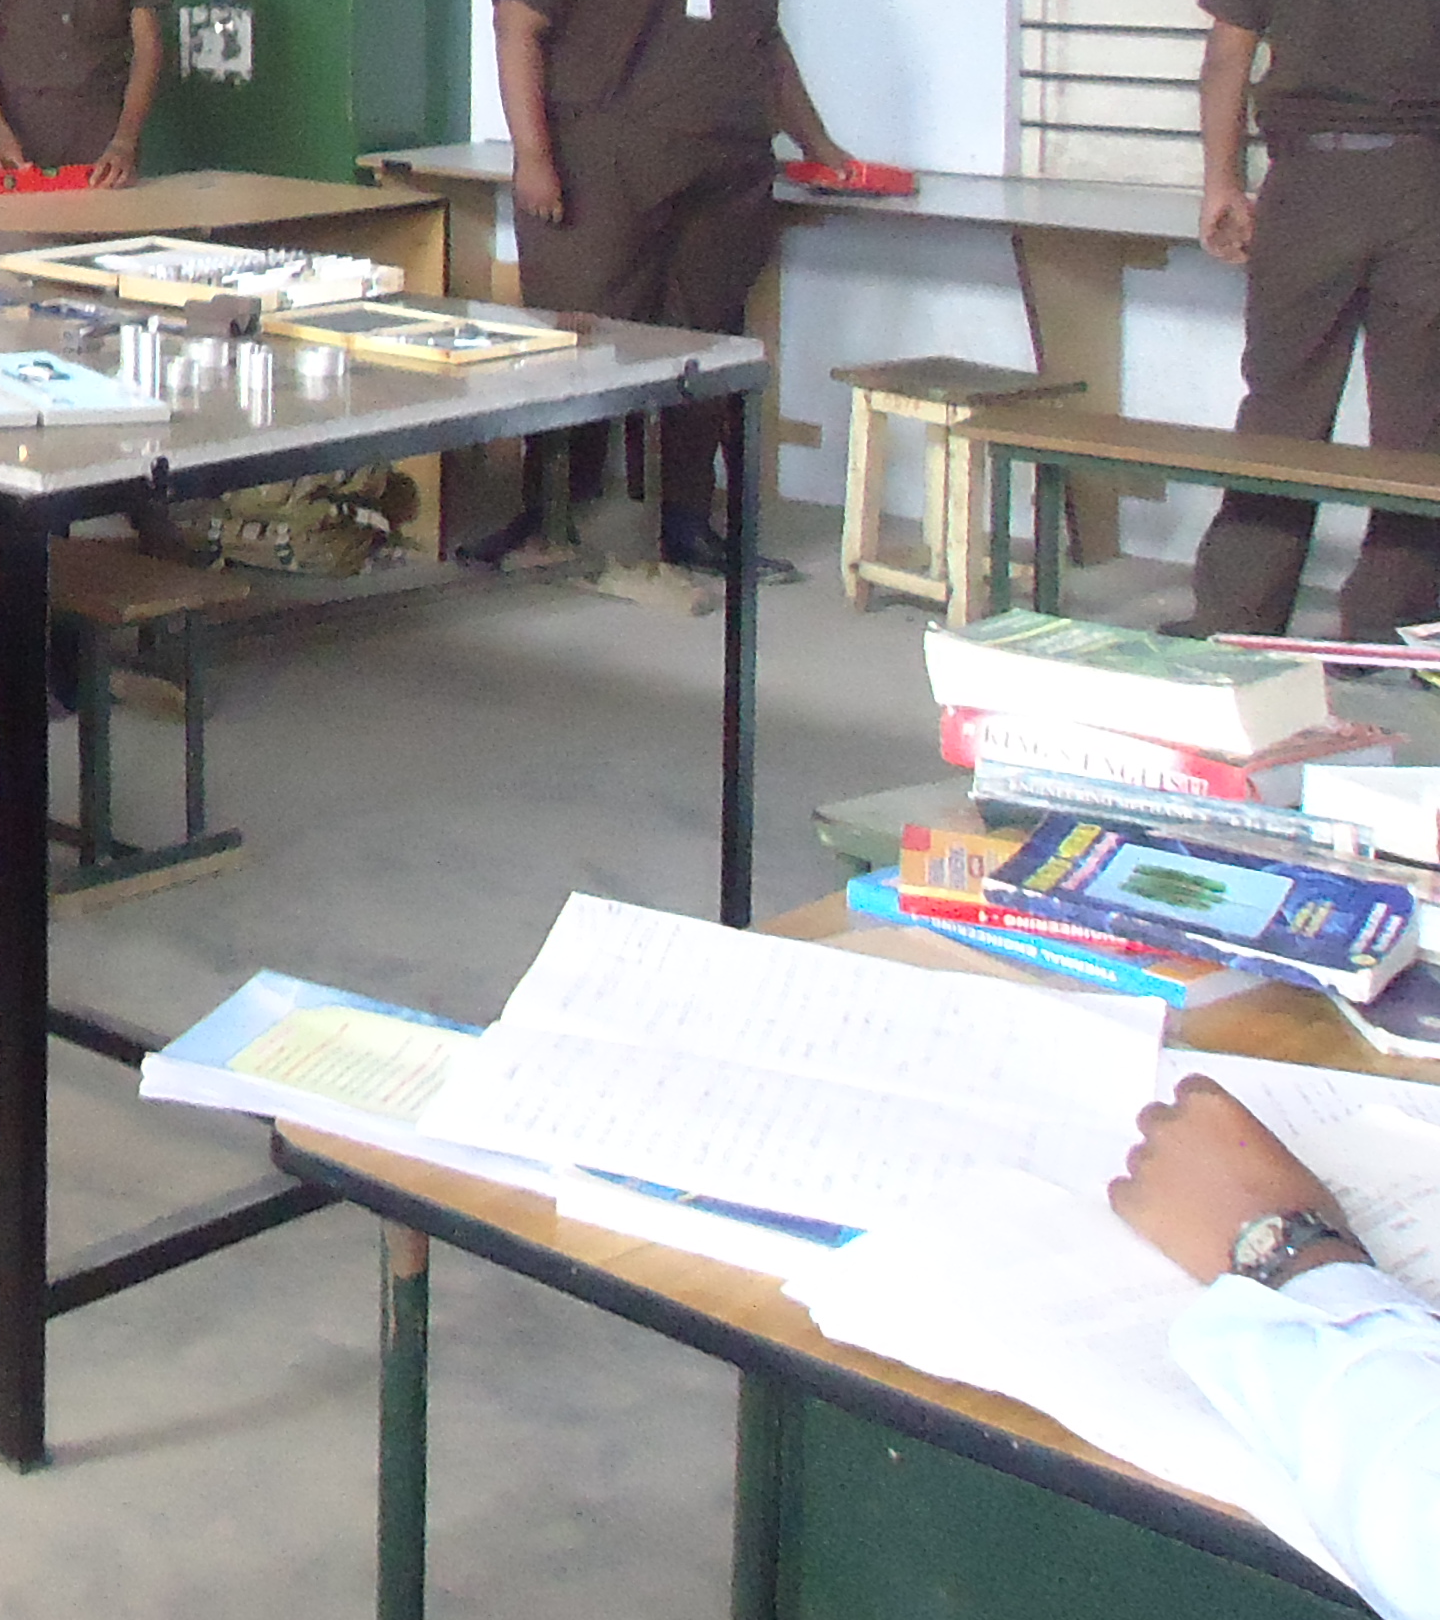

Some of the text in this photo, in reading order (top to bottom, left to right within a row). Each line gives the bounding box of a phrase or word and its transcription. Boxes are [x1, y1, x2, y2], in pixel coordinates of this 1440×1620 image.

[931, 917, 1118, 982] THERMAL ENGINEERING
[1003, 913, 1127, 943] GINEERING
